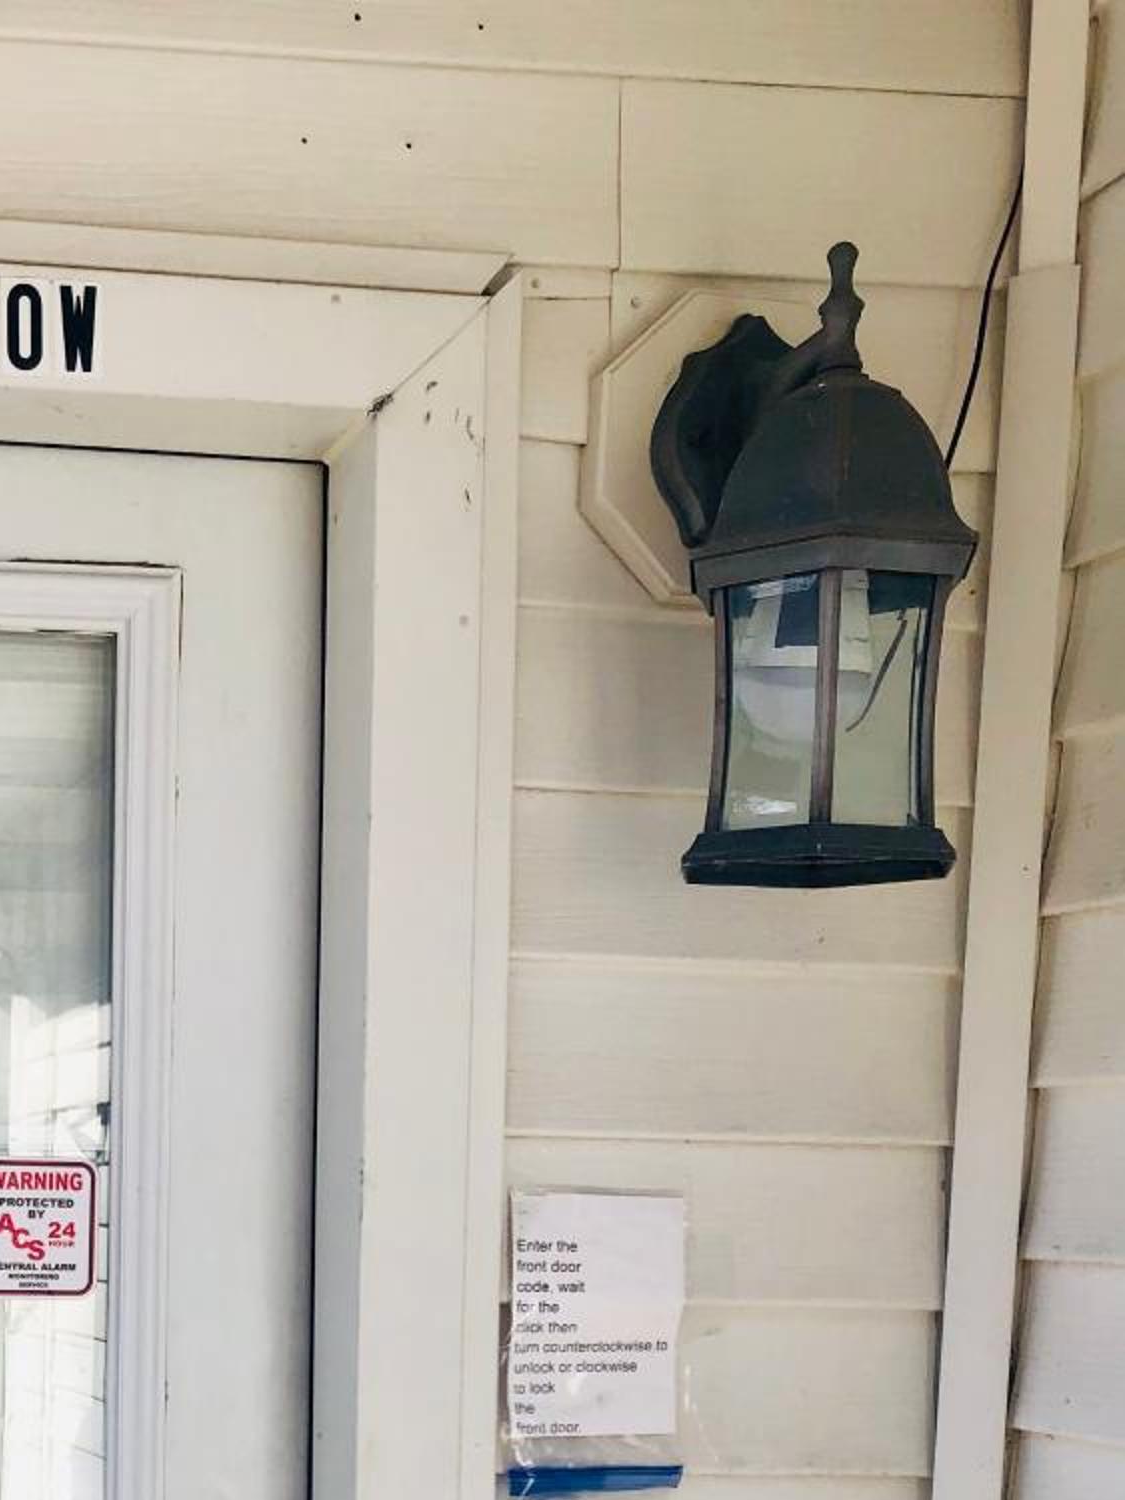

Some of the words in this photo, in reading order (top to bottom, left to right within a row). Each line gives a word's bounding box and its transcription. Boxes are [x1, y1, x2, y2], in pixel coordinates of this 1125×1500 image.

[28, 1210, 45, 1218] BY
[48, 1221, 76, 1239] 24
[516, 1239, 552, 1253] Enter
[557, 1240, 578, 1252] the
[516, 1260, 547, 1273] front
[551, 1260, 582, 1273] door
[516, 1281, 553, 1295] code,
[557, 1282, 585, 1293] wait
[516, 1301, 535, 1313] for
[538, 1301, 560, 1313] the
[515, 1321, 544, 1333] click
[548, 1321, 578, 1333] then
[514, 1342, 540, 1354] turn
[543, 1340, 652, 1353] counterclockwise
[656, 1340, 668, 1351] to
[514, 1362, 555, 1375] unlock
[559, 1364, 572, 1373] or
[575, 1361, 638, 1373] clockwise
[513, 1384, 525, 1395] to
[529, 1381, 555, 1394] lock
[514, 1401, 536, 1415] the
[516, 1421, 546, 1435] front
